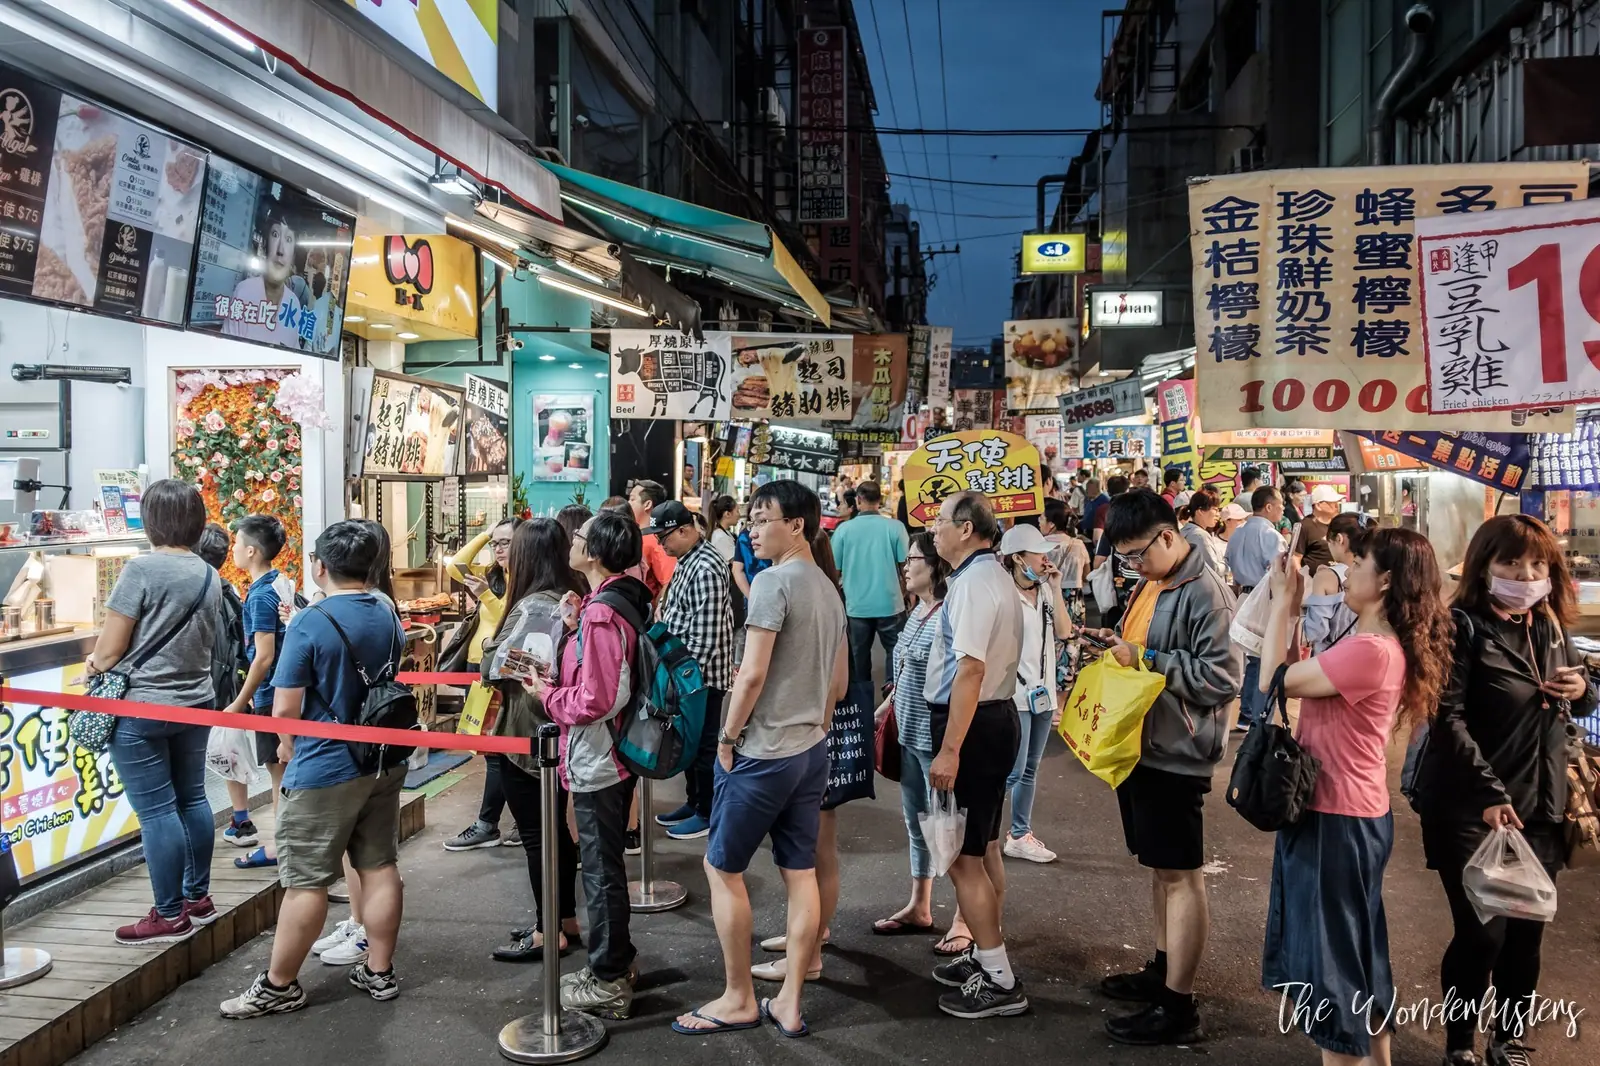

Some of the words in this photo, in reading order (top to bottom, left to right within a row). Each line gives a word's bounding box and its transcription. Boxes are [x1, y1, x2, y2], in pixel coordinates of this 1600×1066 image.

[17, 205, 39, 224] $75
[13, 235, 34, 253] $75
[1201, 194, 1262, 363] 金桔檸檬
[1275, 188, 1337, 356] 珍珠鮮奶茶
[1350, 187, 1416, 359] 蜂蜜檸檬
[1433, 274, 1511, 398] 豆乳雞
[616, 406, 636, 414] Beef
[1442, 399, 1469, 409] Fried
[1472, 396, 1510, 407] chicken
[924, 436, 1011, 474] 天使
[964, 463, 1036, 494] 雞排
[837, 733, 865, 745] resist.
[838, 748, 866, 760] resist.
[24, 809, 75, 838] Chicken
